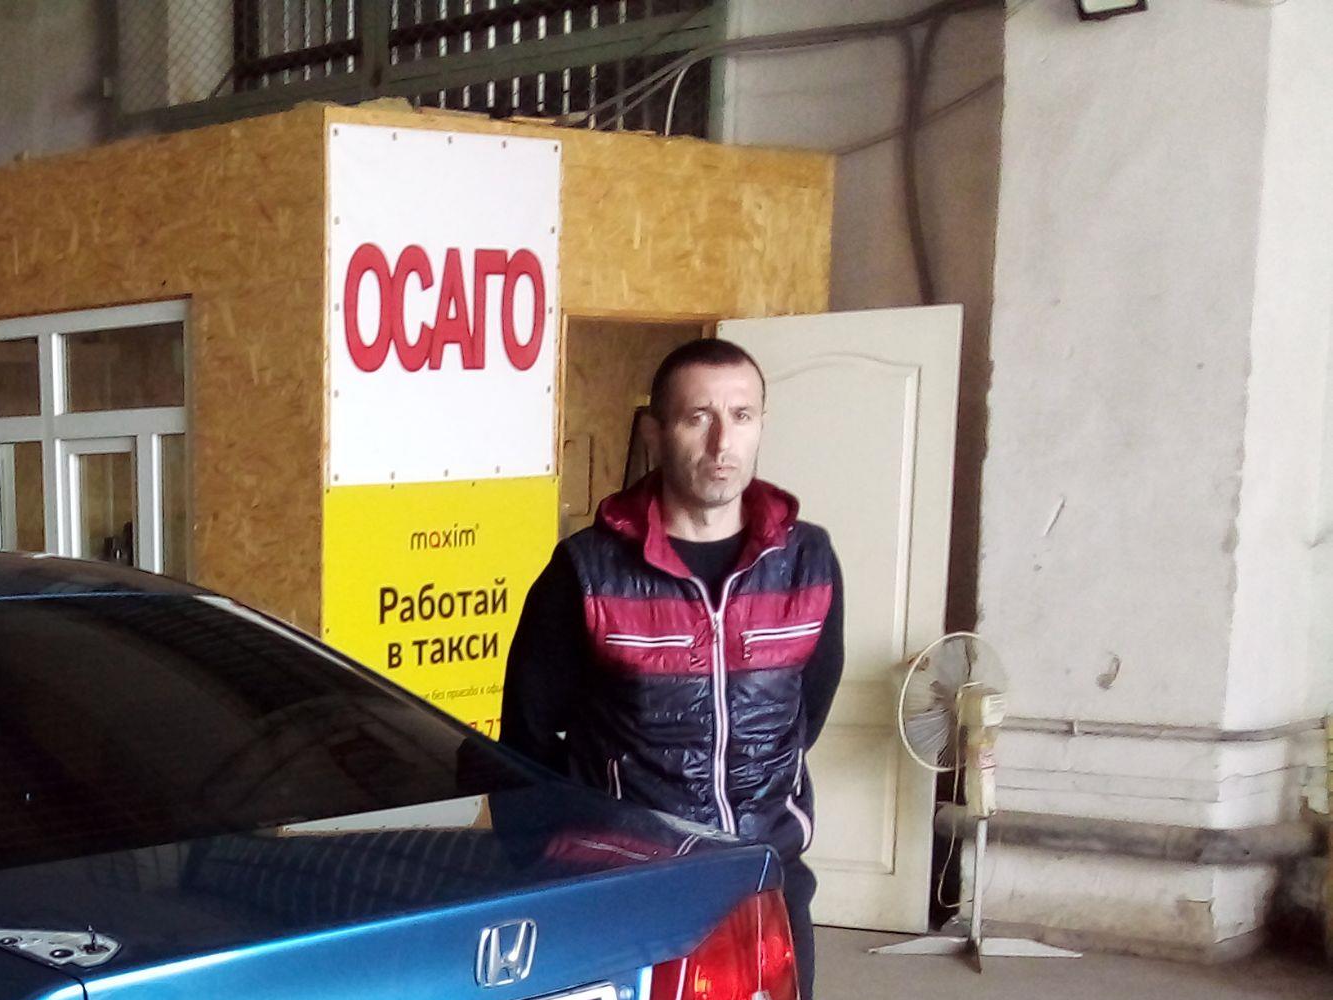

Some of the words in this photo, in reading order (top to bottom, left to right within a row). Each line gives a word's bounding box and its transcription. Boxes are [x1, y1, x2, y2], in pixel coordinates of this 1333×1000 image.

[344, 243, 545, 372] ОСАГО
[410, 523, 475, 550] maxim
[379, 577, 507, 624] Работай
[388, 642, 402, 669] в
[412, 632, 498, 666] такси
